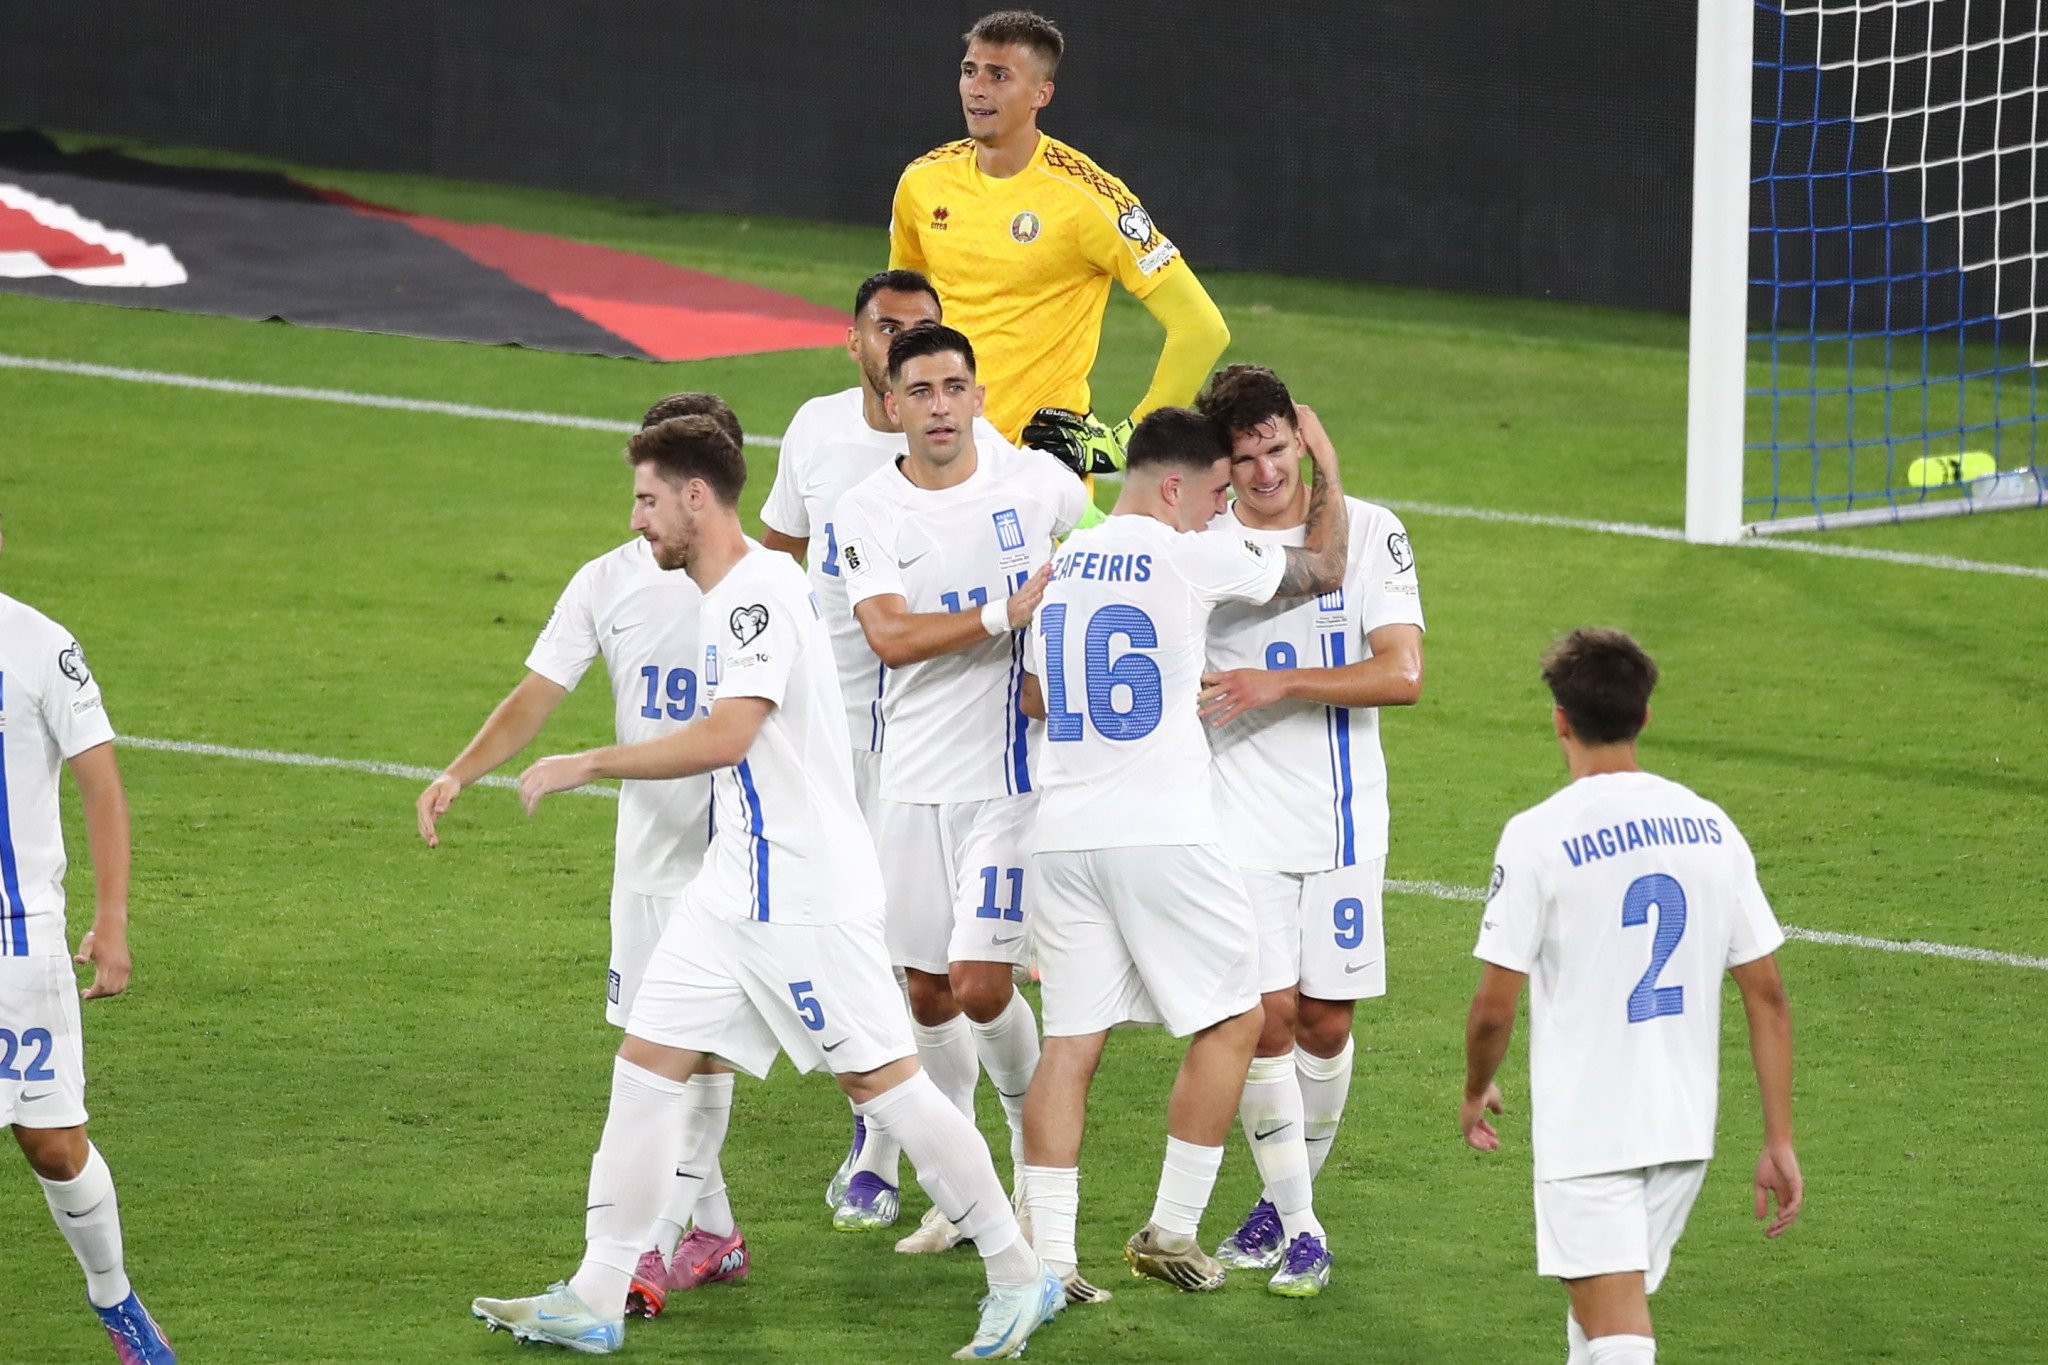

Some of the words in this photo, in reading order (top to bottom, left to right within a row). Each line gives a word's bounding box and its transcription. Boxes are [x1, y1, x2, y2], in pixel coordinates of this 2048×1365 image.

[1047, 551, 1153, 583] ZAFEIRIS
[640, 665, 698, 722] 19
[1040, 602, 1164, 742] 16
[1562, 816, 1723, 868] VAGIANNIDIS
[976, 865, 1025, 923] 11
[1333, 897, 1364, 950] 9
[1621, 872, 1688, 1024] 2
[788, 980, 826, 1031] 5
[0, 1027, 56, 1081] 22
